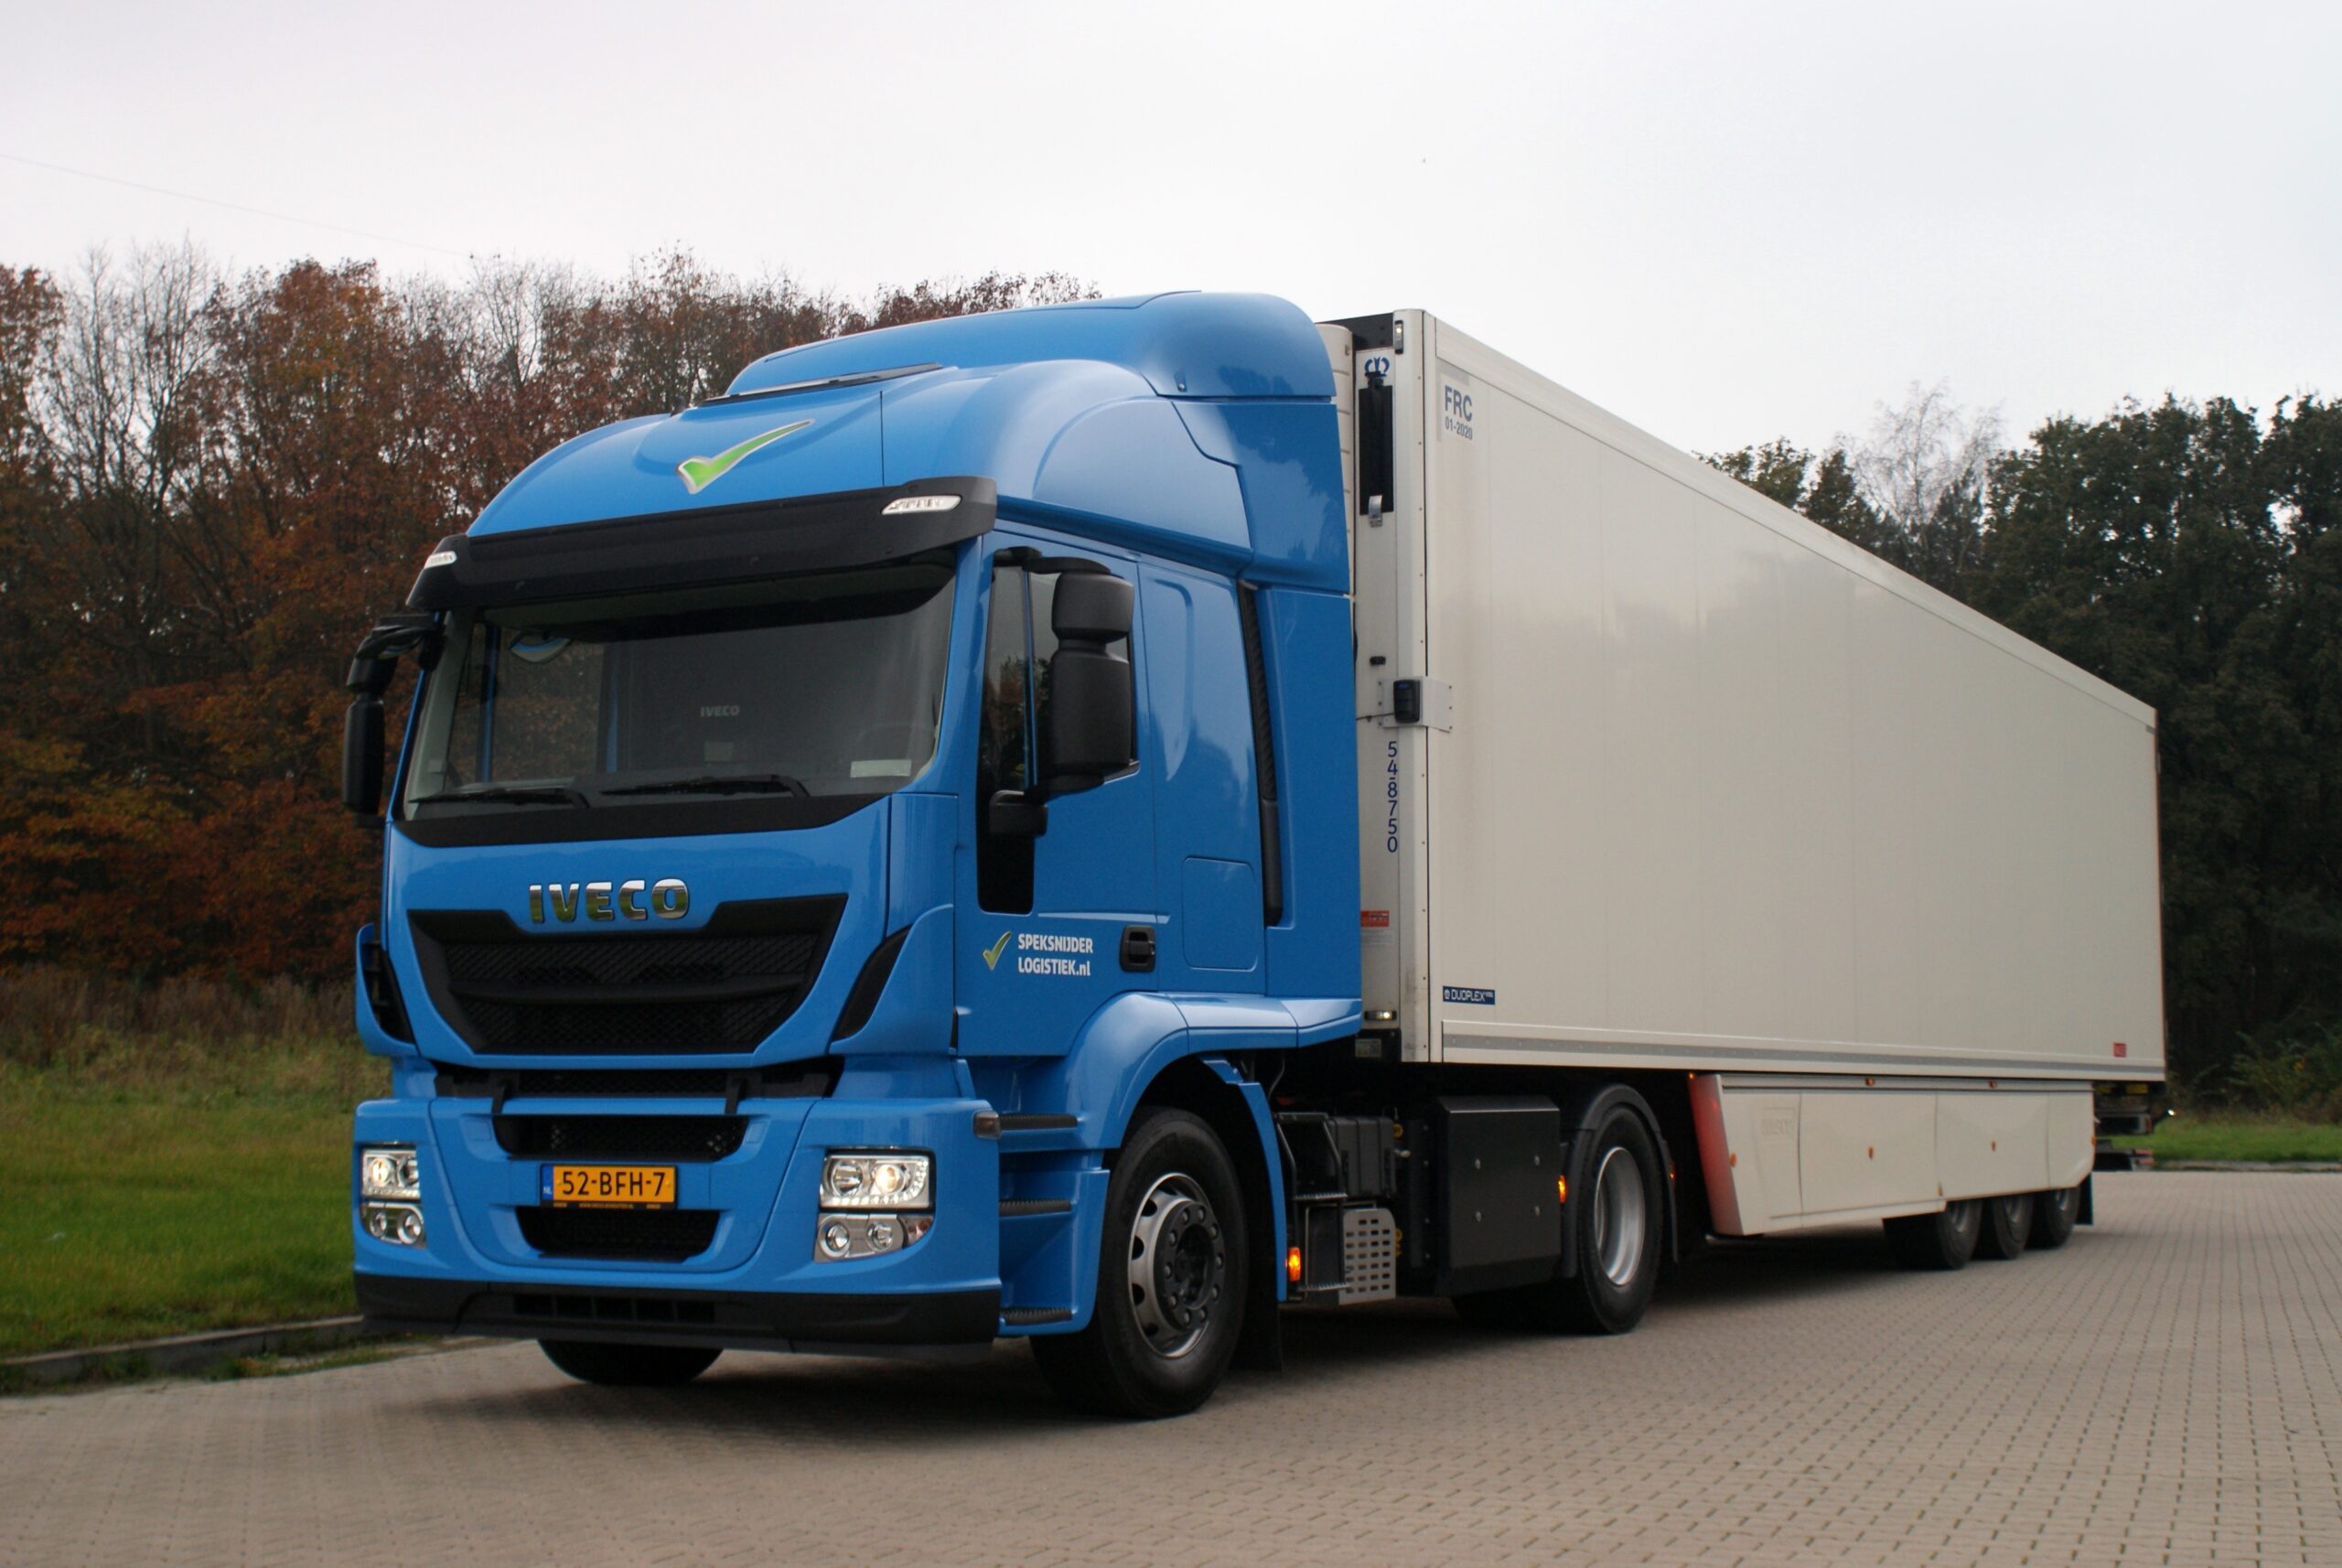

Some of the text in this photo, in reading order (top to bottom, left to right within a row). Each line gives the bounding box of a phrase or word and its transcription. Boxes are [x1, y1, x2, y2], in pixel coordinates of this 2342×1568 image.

[1445, 385, 1473, 422] FRC
[1445, 416, 1473, 441] 01-2020
[700, 705, 740, 717] IVECO
[529, 877, 690, 923] IVECO
[1017, 933, 1093, 953] SPEKSNIJDER
[1017, 957, 1090, 976] LOGISTIEK.nl
[1451, 989, 1485, 1002] DUOPLEX
[543, 1187, 553, 1195] NL
[562, 1171, 666, 1197] 52-BFH-7
